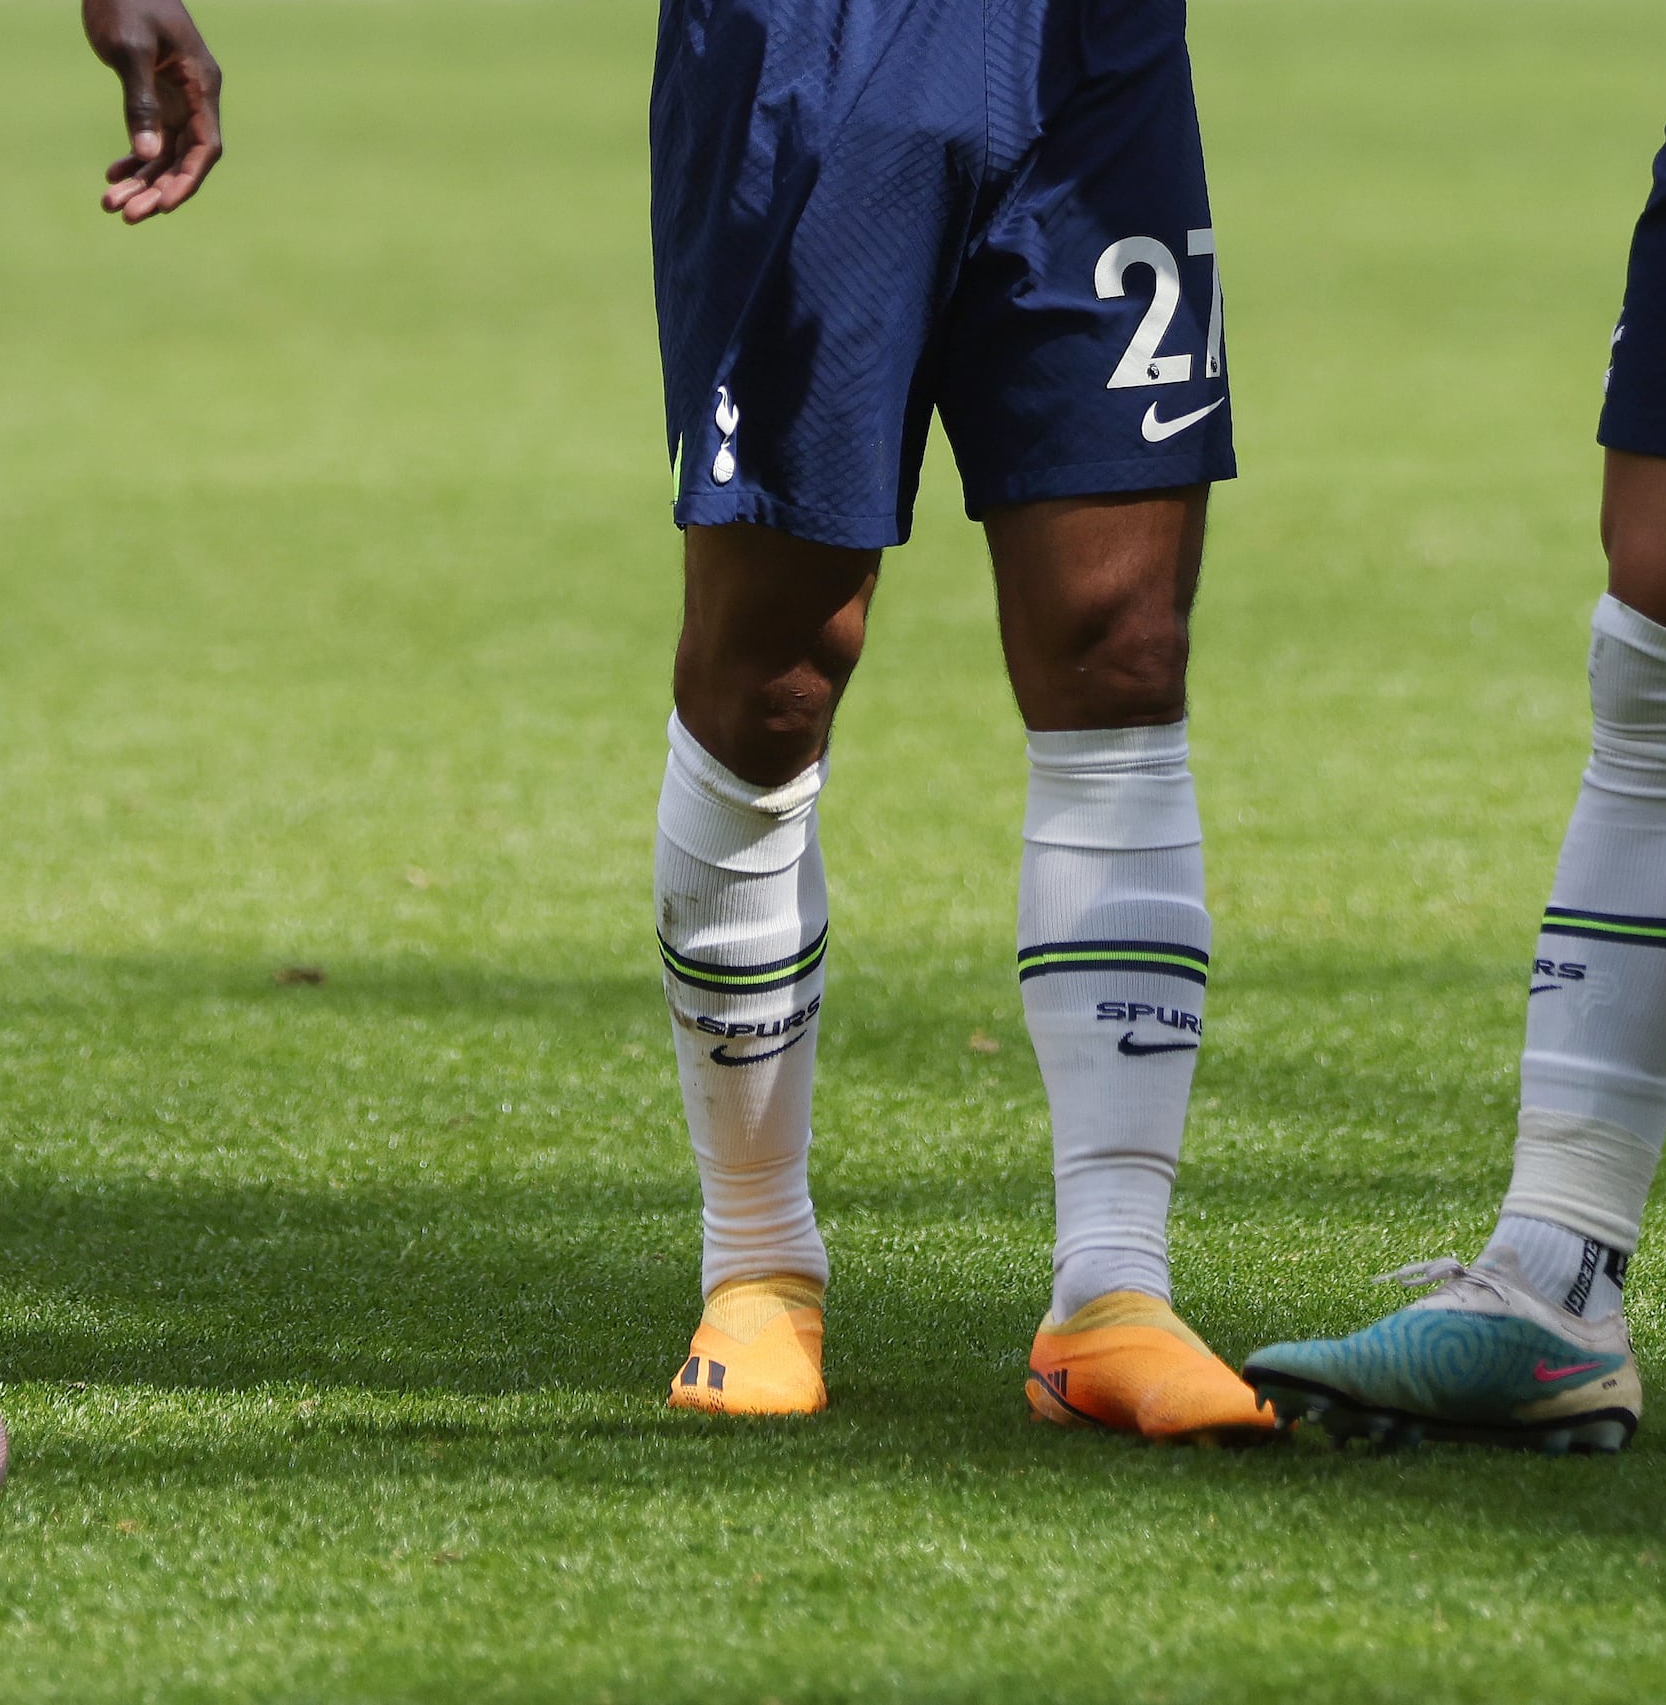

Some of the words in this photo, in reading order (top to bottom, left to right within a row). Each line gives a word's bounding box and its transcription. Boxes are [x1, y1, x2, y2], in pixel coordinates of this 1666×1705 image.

[1094, 228, 1223, 390] 27
[696, 993, 821, 1038] SPURS
[1096, 1001, 1203, 1037] SPUR
